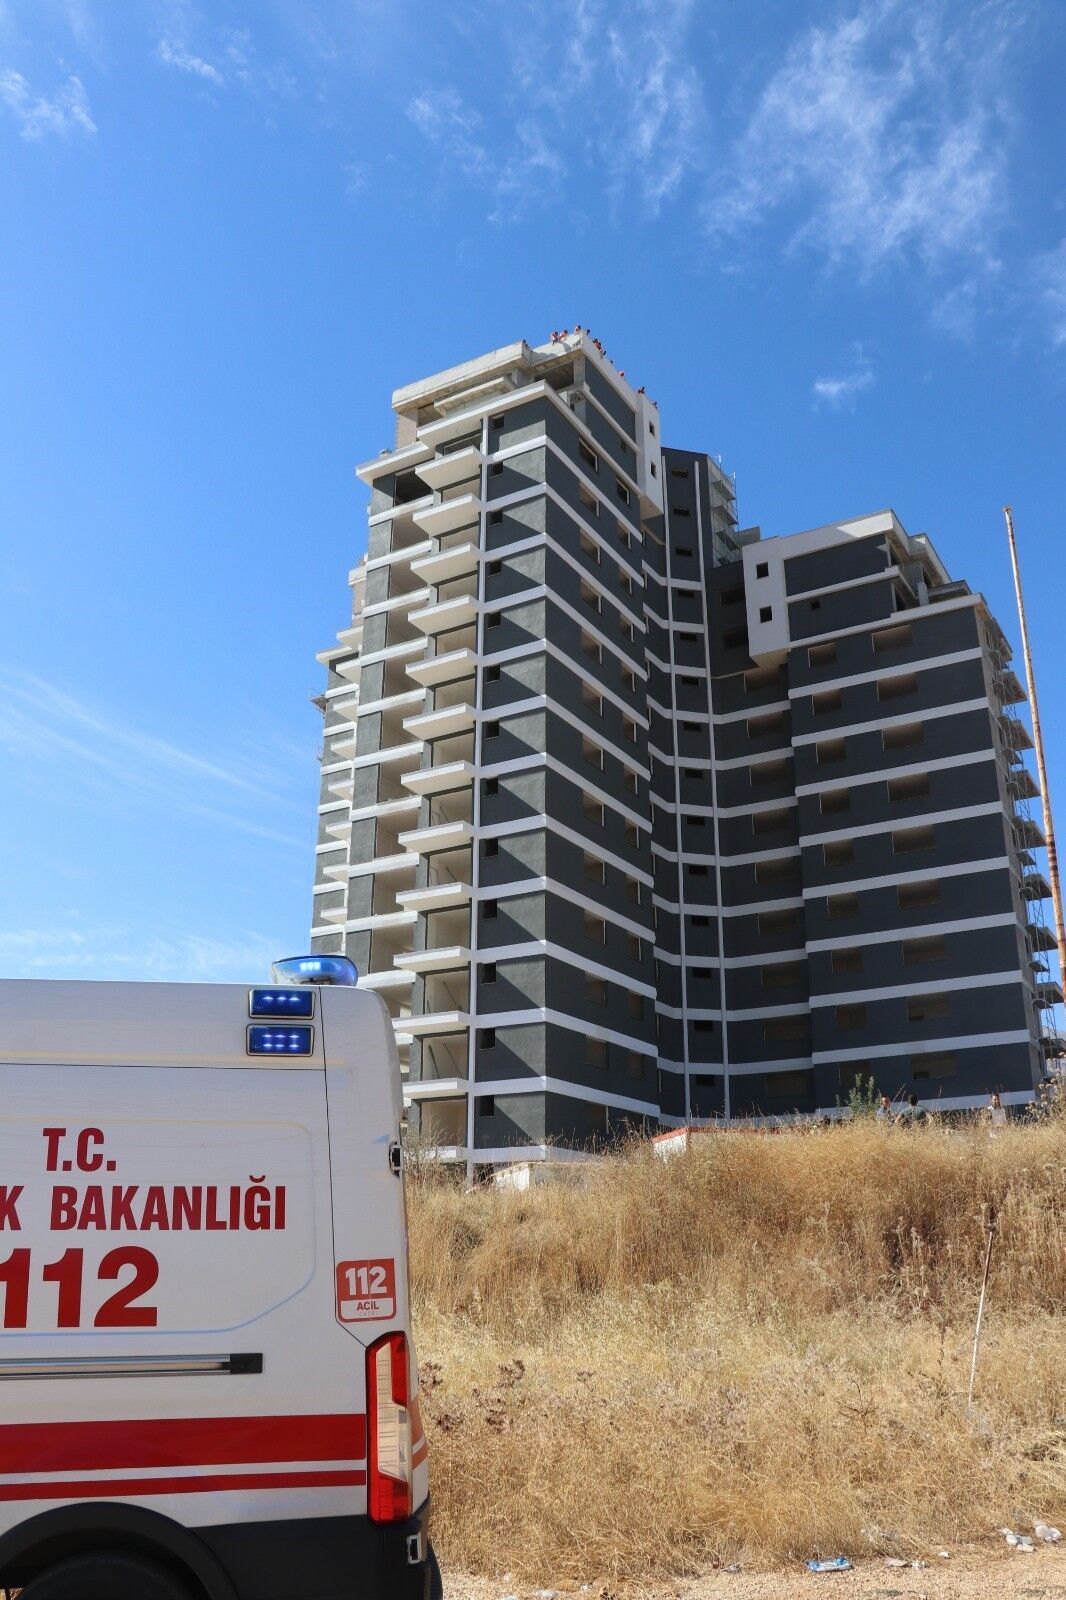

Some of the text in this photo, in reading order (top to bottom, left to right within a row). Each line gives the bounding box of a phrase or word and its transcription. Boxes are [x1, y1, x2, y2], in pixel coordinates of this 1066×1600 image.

[42, 1127, 117, 1172] T.C.
[50, 1174, 287, 1231] BAKANLIĞI
[0, 1245, 160, 1329] 112
[345, 1265, 388, 1296] 112
